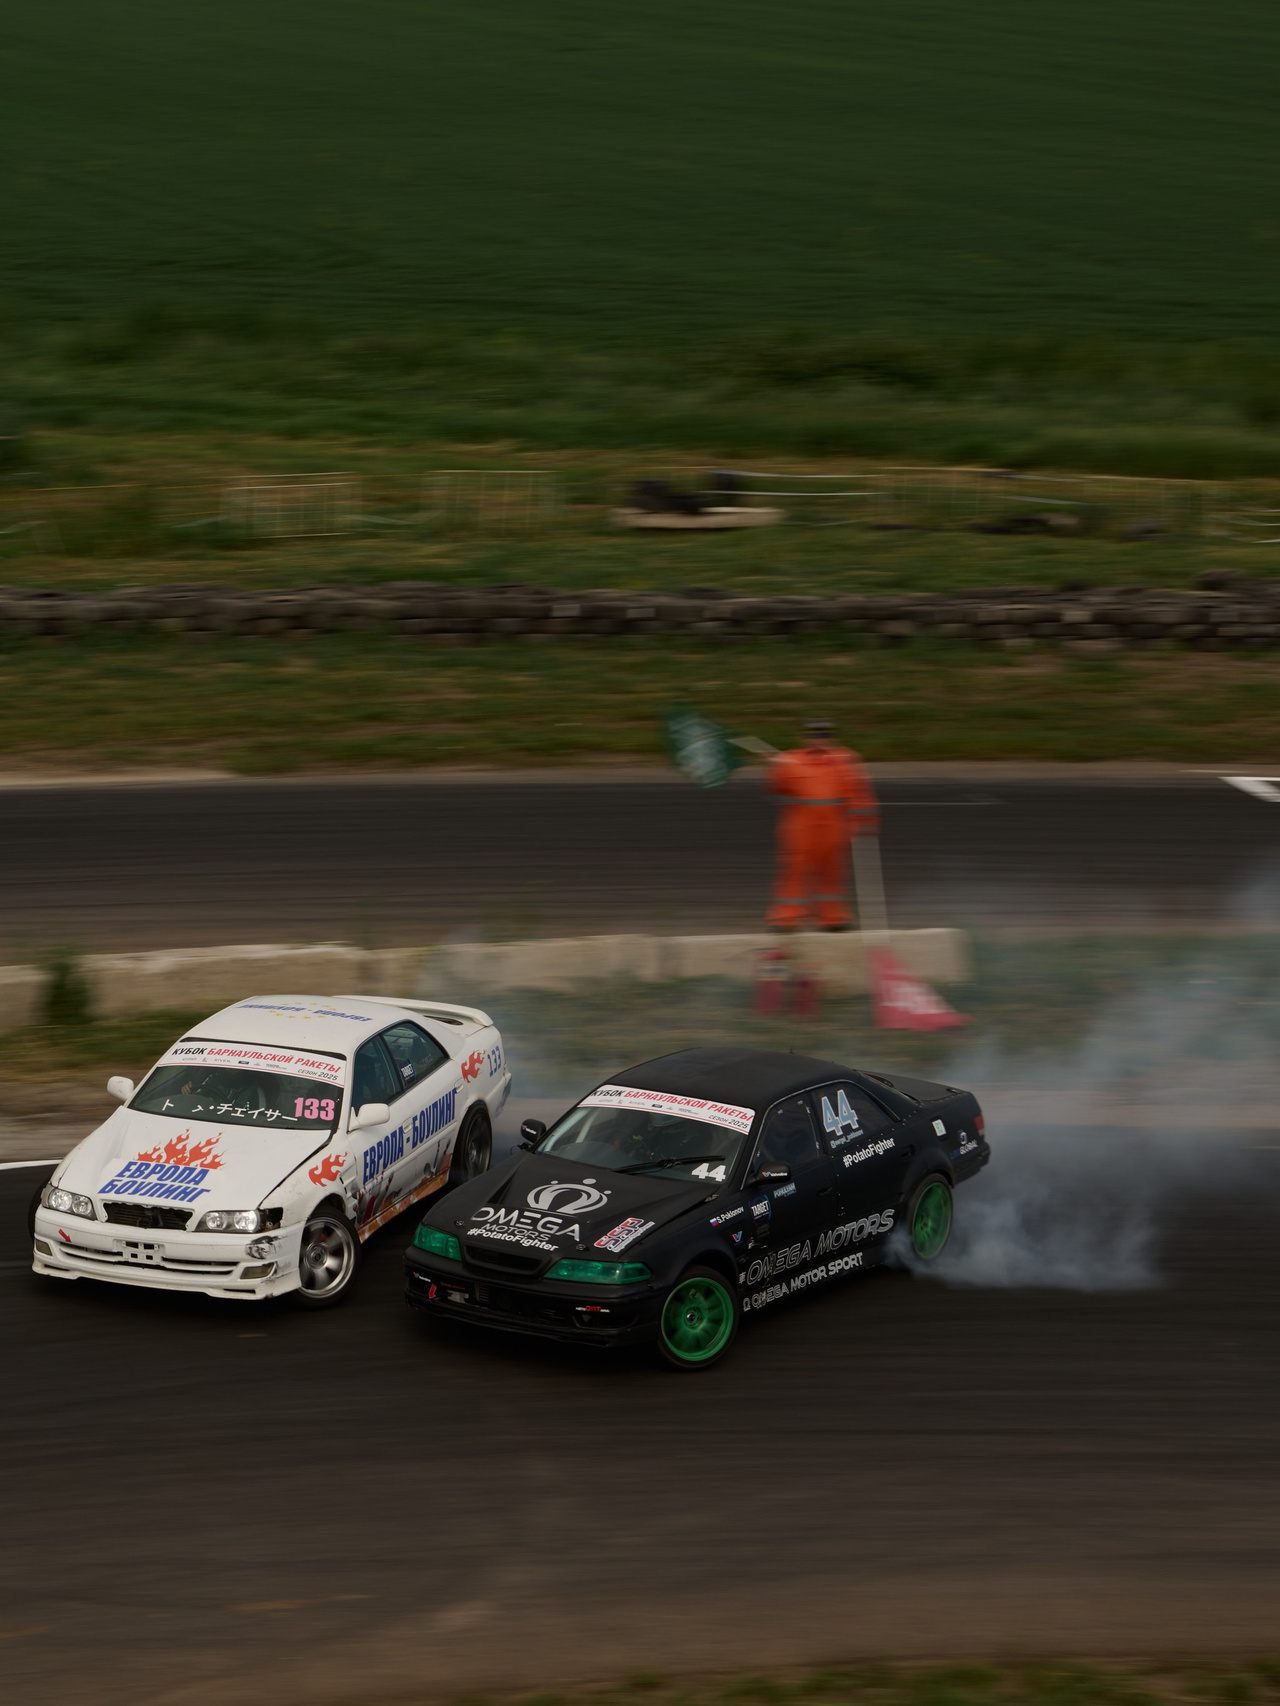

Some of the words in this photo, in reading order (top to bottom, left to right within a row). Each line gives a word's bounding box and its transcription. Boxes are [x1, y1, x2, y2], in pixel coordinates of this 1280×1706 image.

[172, 1047, 207, 1056] КУБОК
[207, 1048, 294, 1064] БАРНАУЛЬСКОЙ
[294, 1057, 341, 1073] РАКЕТЫ
[487, 1046, 501, 1077] 133
[298, 1069, 318, 1077] СЕЗОН
[318, 1071, 338, 1081] 2025
[294, 1097, 335, 1121] 133
[591, 1089, 625, 1097] КУБОК
[624, 1090, 707, 1109] БАРНАУЛЬСКОЙ
[707, 1104, 754, 1121] РАКЕТЫ
[821, 1089, 859, 1136] 44
[709, 1114, 728, 1123] СЕЗОН
[728, 1118, 749, 1129] 2025
[363, 1125, 404, 1185] ЕВРОПА
[411, 1087, 458, 1149] БОУЛИНГ
[843, 1137, 896, 1168] #PotatoFighter
[115, 1161, 210, 1185] ЕВРОПА
[691, 1163, 726, 1182] 44
[97, 1178, 211, 1202] БОУЛИНГ
[716, 1206, 744, 1224] S.Poklonov
[751, 1200, 769, 1216] TARGET
[470, 1207, 580, 1242] OMEGA
[481, 1222, 552, 1241] MOTORS
[467, 1227, 559, 1252] #PotatoFighter
[746, 1239, 812, 1285] OMEGA
[814, 1208, 895, 1258] MOTORS
[790, 1266, 828, 1292] MOTOR
[828, 1252, 863, 1276] SPORT
